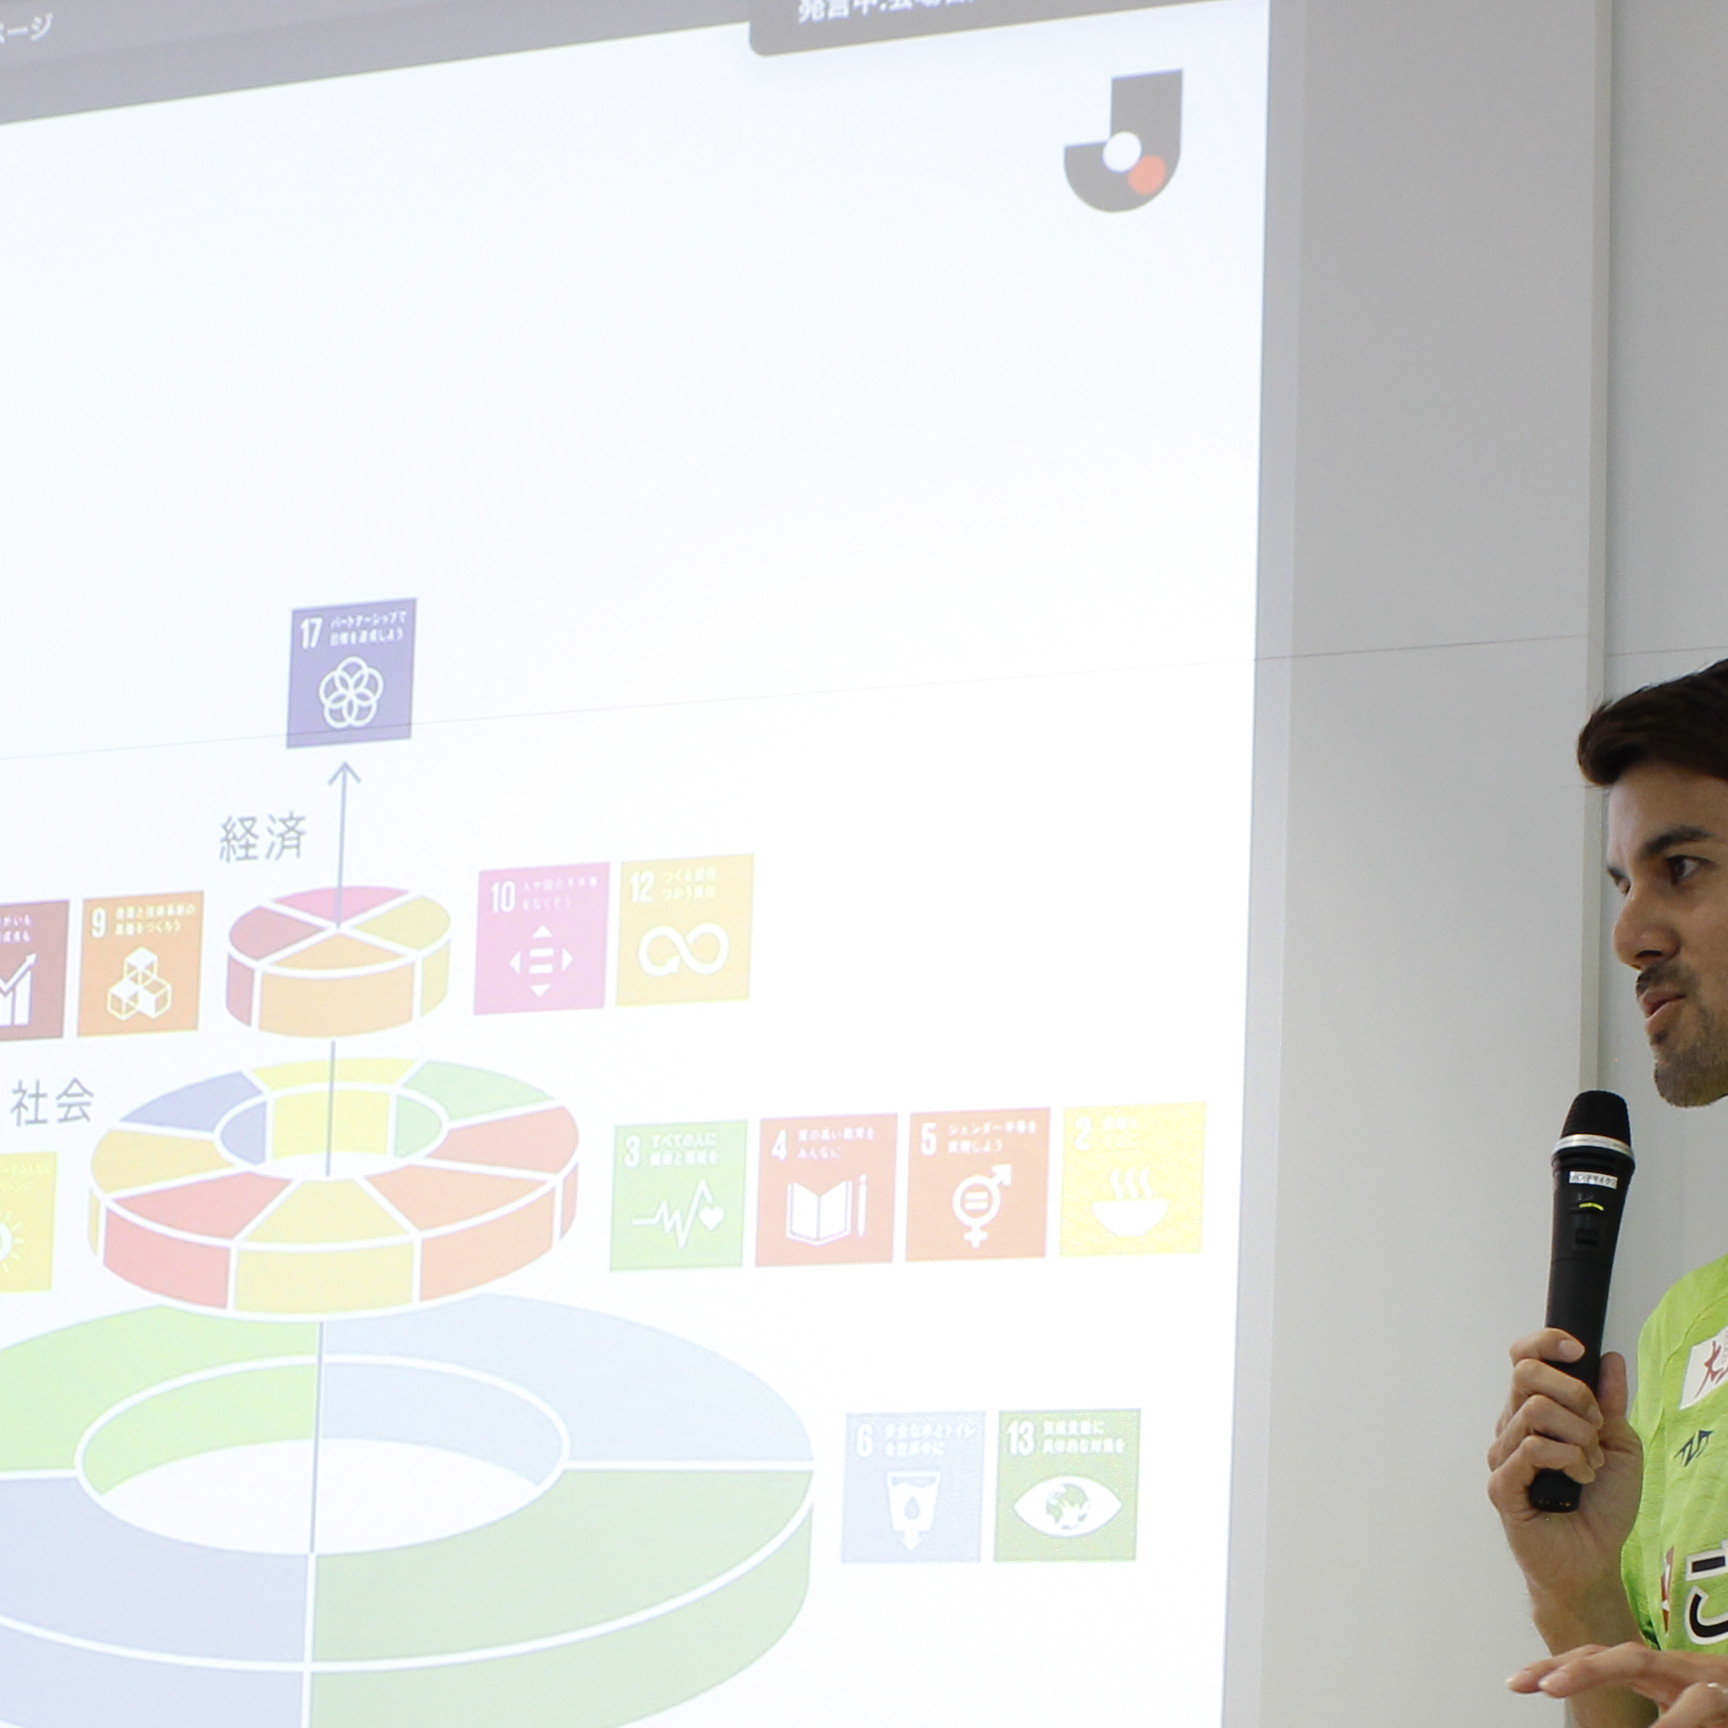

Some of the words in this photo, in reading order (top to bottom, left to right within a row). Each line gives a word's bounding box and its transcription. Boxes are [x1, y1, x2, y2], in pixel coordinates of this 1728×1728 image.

[301, 618, 322, 649] 17
[219, 811, 306, 863] 経済
[492, 881, 515, 913] 10
[630, 870, 654, 903] 12
[92, 908, 106, 938] 9
[10, 1077, 94, 1128] 社会
[772, 1130, 787, 1160] 4
[921, 1123, 937, 1155] 5
[1075, 1117, 1091, 1150] 2
[625, 1136, 640, 1168] 3
[856, 1423, 873, 1457] 6
[1007, 1421, 1034, 1455] 13
